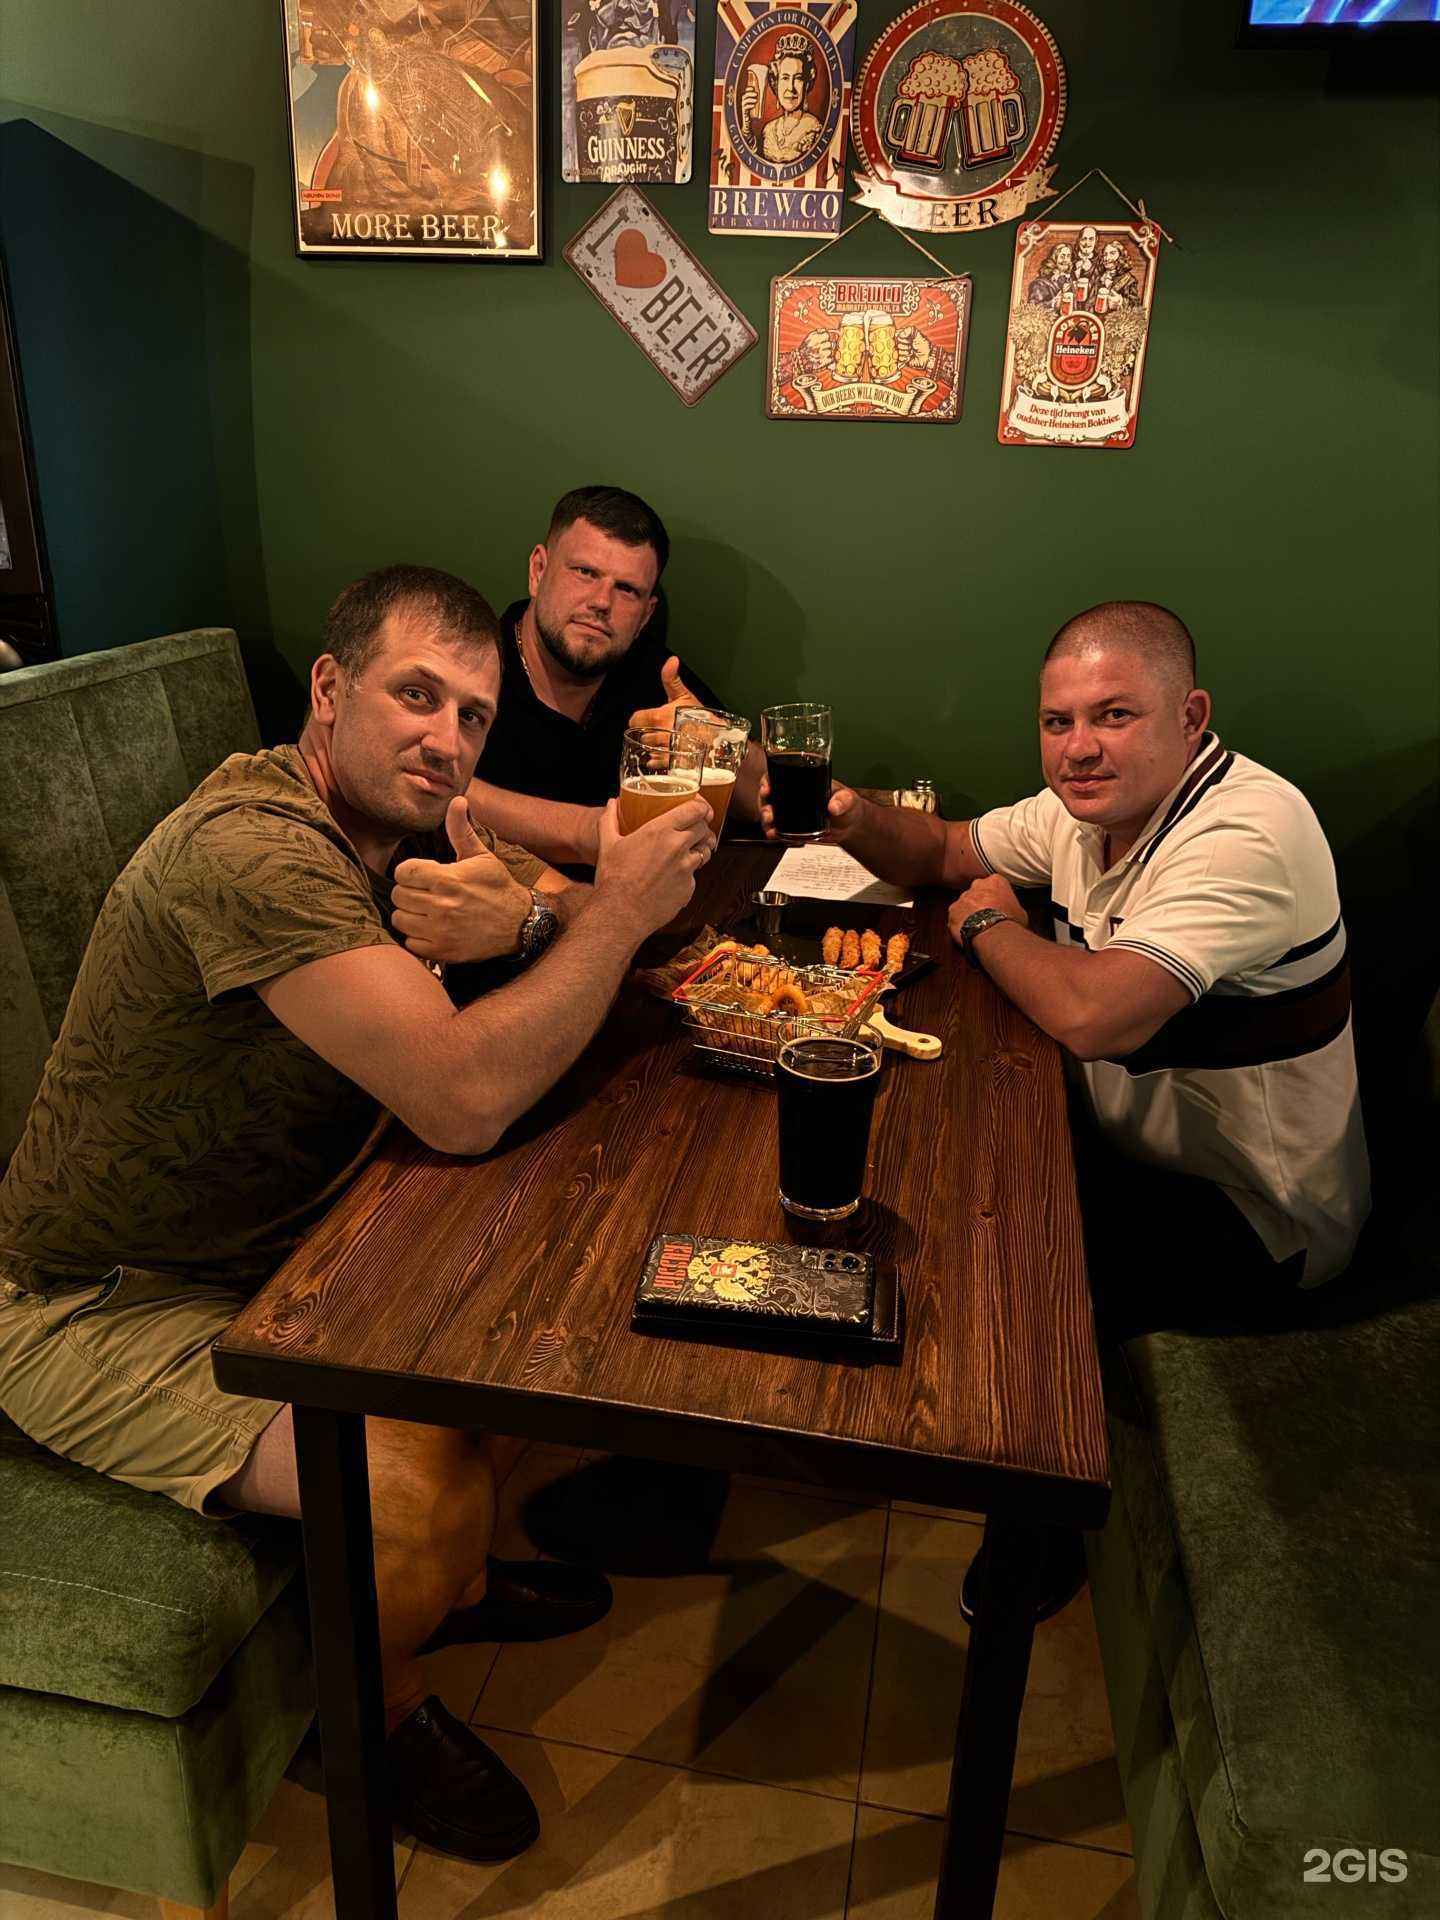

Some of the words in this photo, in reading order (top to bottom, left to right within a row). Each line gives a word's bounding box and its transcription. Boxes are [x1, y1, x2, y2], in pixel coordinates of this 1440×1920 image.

[732, 16, 774, 68] CAMPAIGN
[777, 10, 801, 24] FOR
[801, 14, 823, 41] REAL
[823, 40, 838, 72] ALES
[587, 135, 666, 163] GUINNESS
[729, 123, 745, 155] GOD
[747, 157, 775, 178] SAVE
[783, 162, 807, 178] THE
[811, 127, 834, 160] ALES
[602, 161, 647, 176] DRAUGHT
[713, 190, 840, 220] BREWCO
[907, 197, 1001, 228] EER
[331, 213, 414, 241] MORE
[421, 214, 502, 241] BEER
[711, 216, 737, 227] PUB
[764, 218, 840, 230] ALEHOUSE
[836, 284, 902, 304] BREWCO
[640, 275, 731, 381] BEER
[1056, 345, 1095, 355] Heineken
[821, 395, 836, 408] OUR
[836, 387, 856, 403] BEERS
[857, 386, 873, 401] WILL
[874, 387, 891, 404] ROCK
[891, 393, 905, 409] YOU
[1016, 413, 1048, 427] oudsher
[1048, 418, 1087, 428] Heineken
[1030, 404, 1049, 416] Deze
[1050, 407, 1063, 418] tijd
[1063, 408, 1090, 419] brengt
[1090, 407, 1106, 416] van
